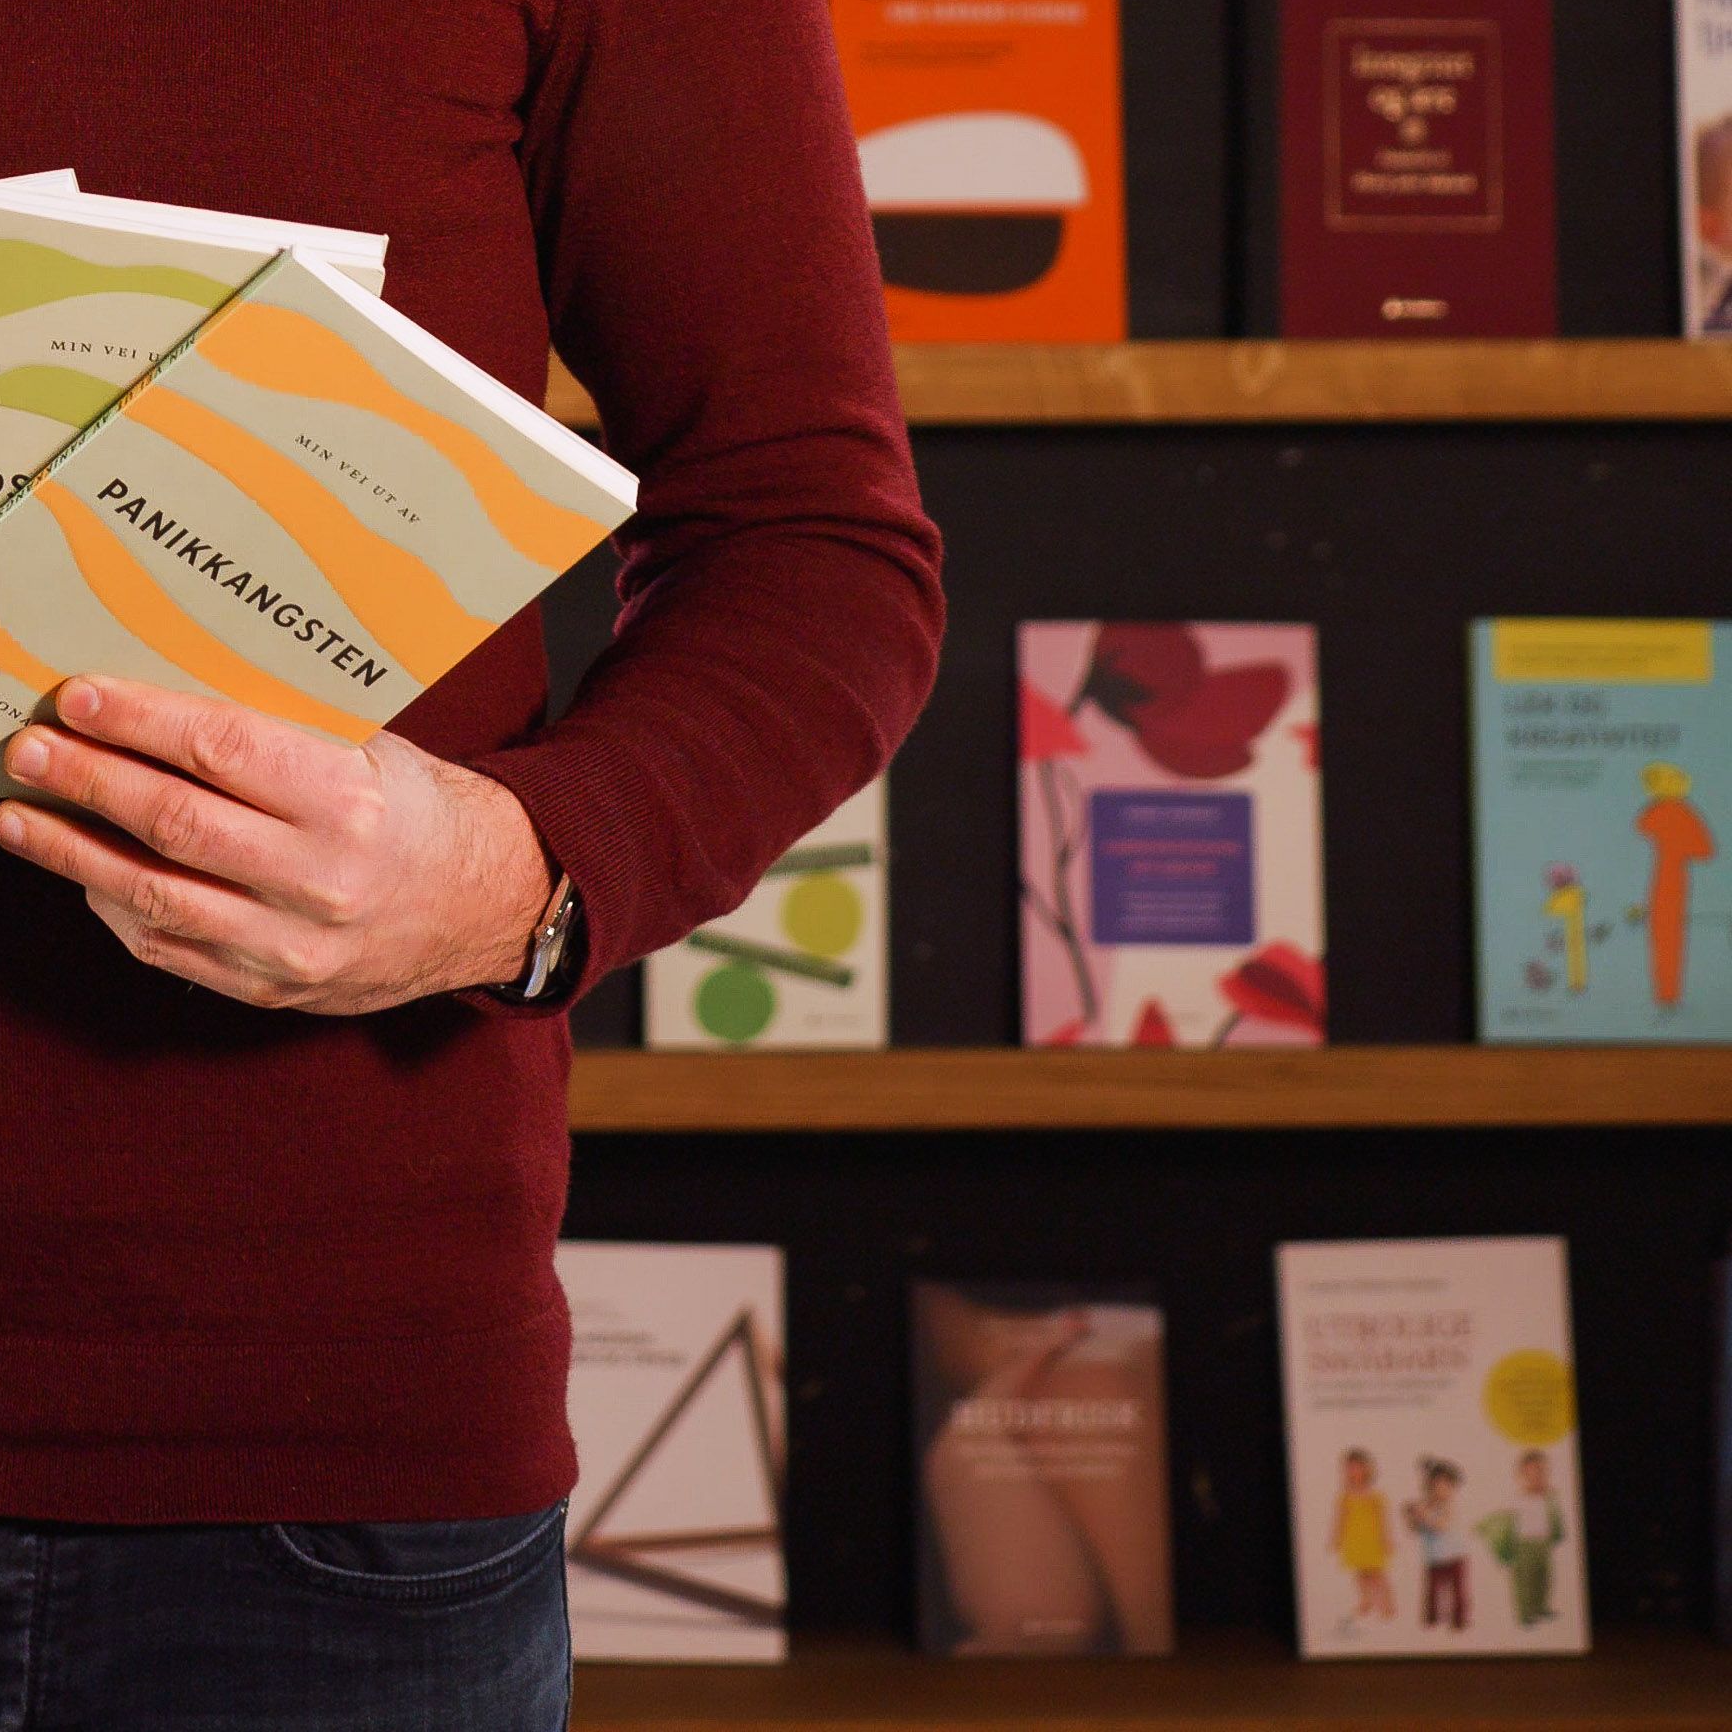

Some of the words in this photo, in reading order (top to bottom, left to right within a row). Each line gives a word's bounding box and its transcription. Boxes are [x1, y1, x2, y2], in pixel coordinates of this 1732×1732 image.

[51, 340, 92, 353] MIN
[104, 345, 136, 359] VEI
[295, 434, 333, 461] MIN
[339, 461, 368, 485] VEI
[372, 485, 397, 504] UT
[397, 508, 421, 523] AV
[97, 478, 388, 688] PANIKKANGSTEN
